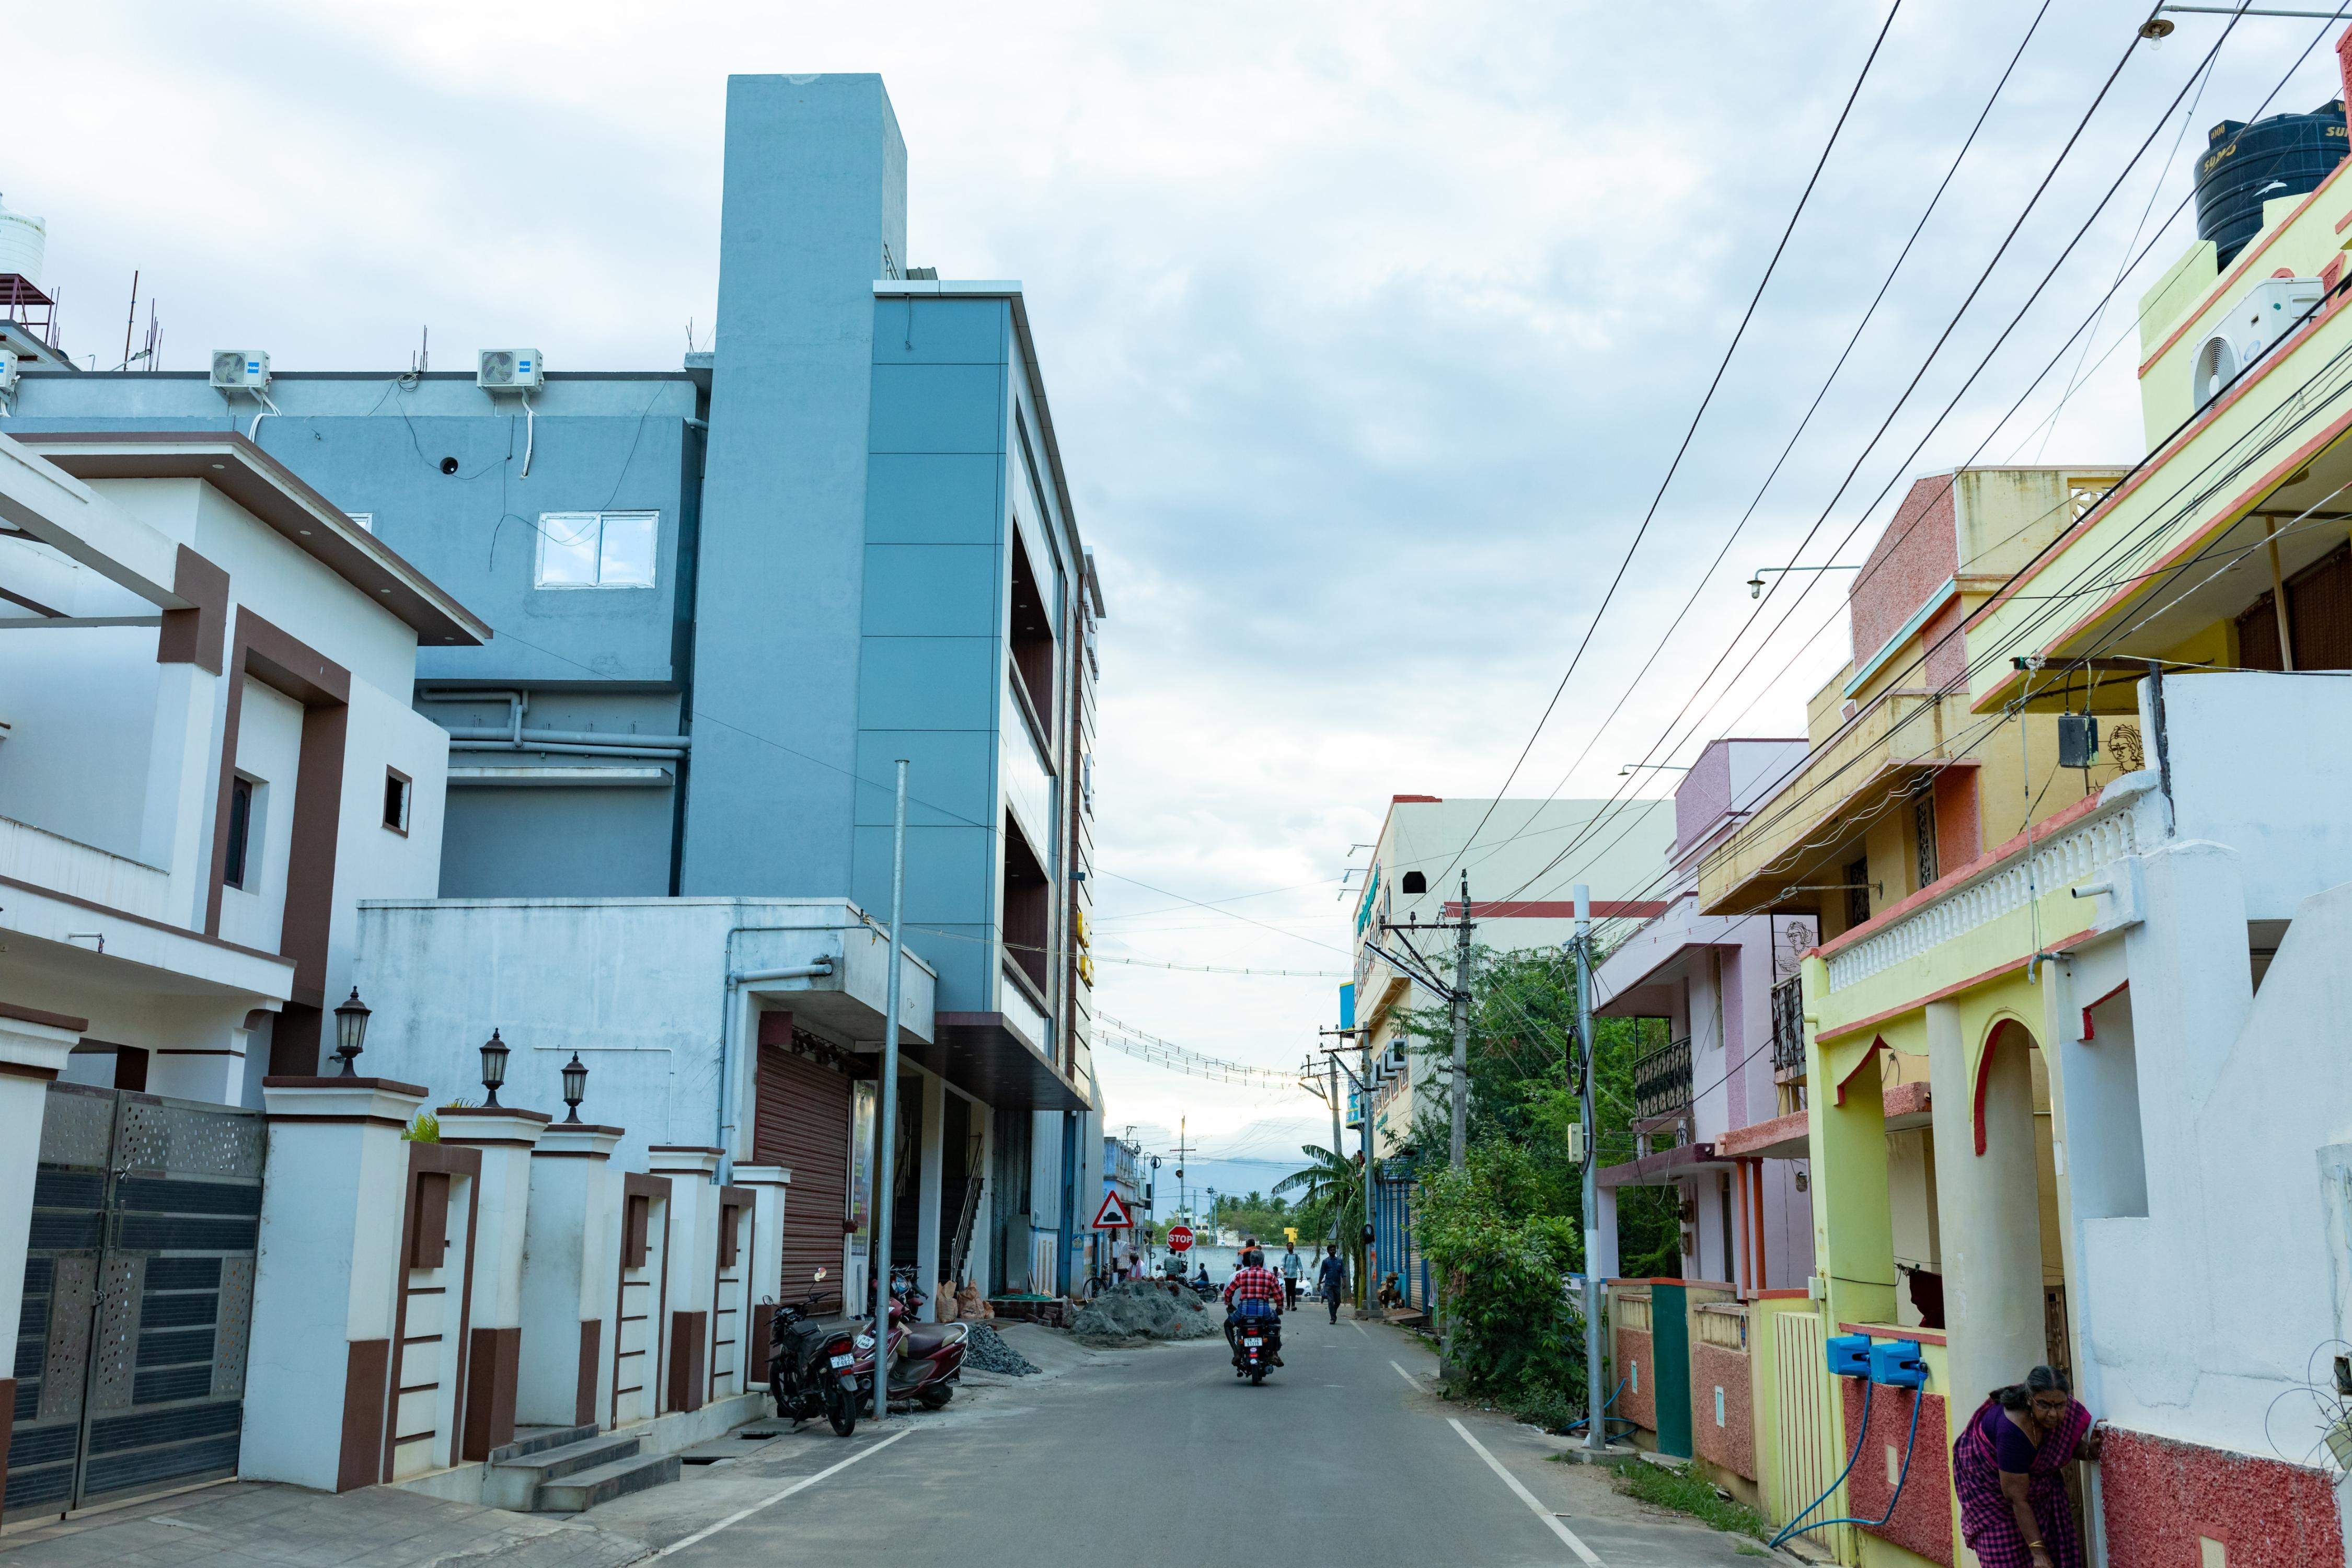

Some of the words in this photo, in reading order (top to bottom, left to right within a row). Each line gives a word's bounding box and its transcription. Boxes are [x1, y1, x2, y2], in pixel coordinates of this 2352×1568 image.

[2211, 124, 2225, 140] 1000
[2204, 144, 2236, 172] SUMO
[1169, 1234, 1192, 1243] STOP
